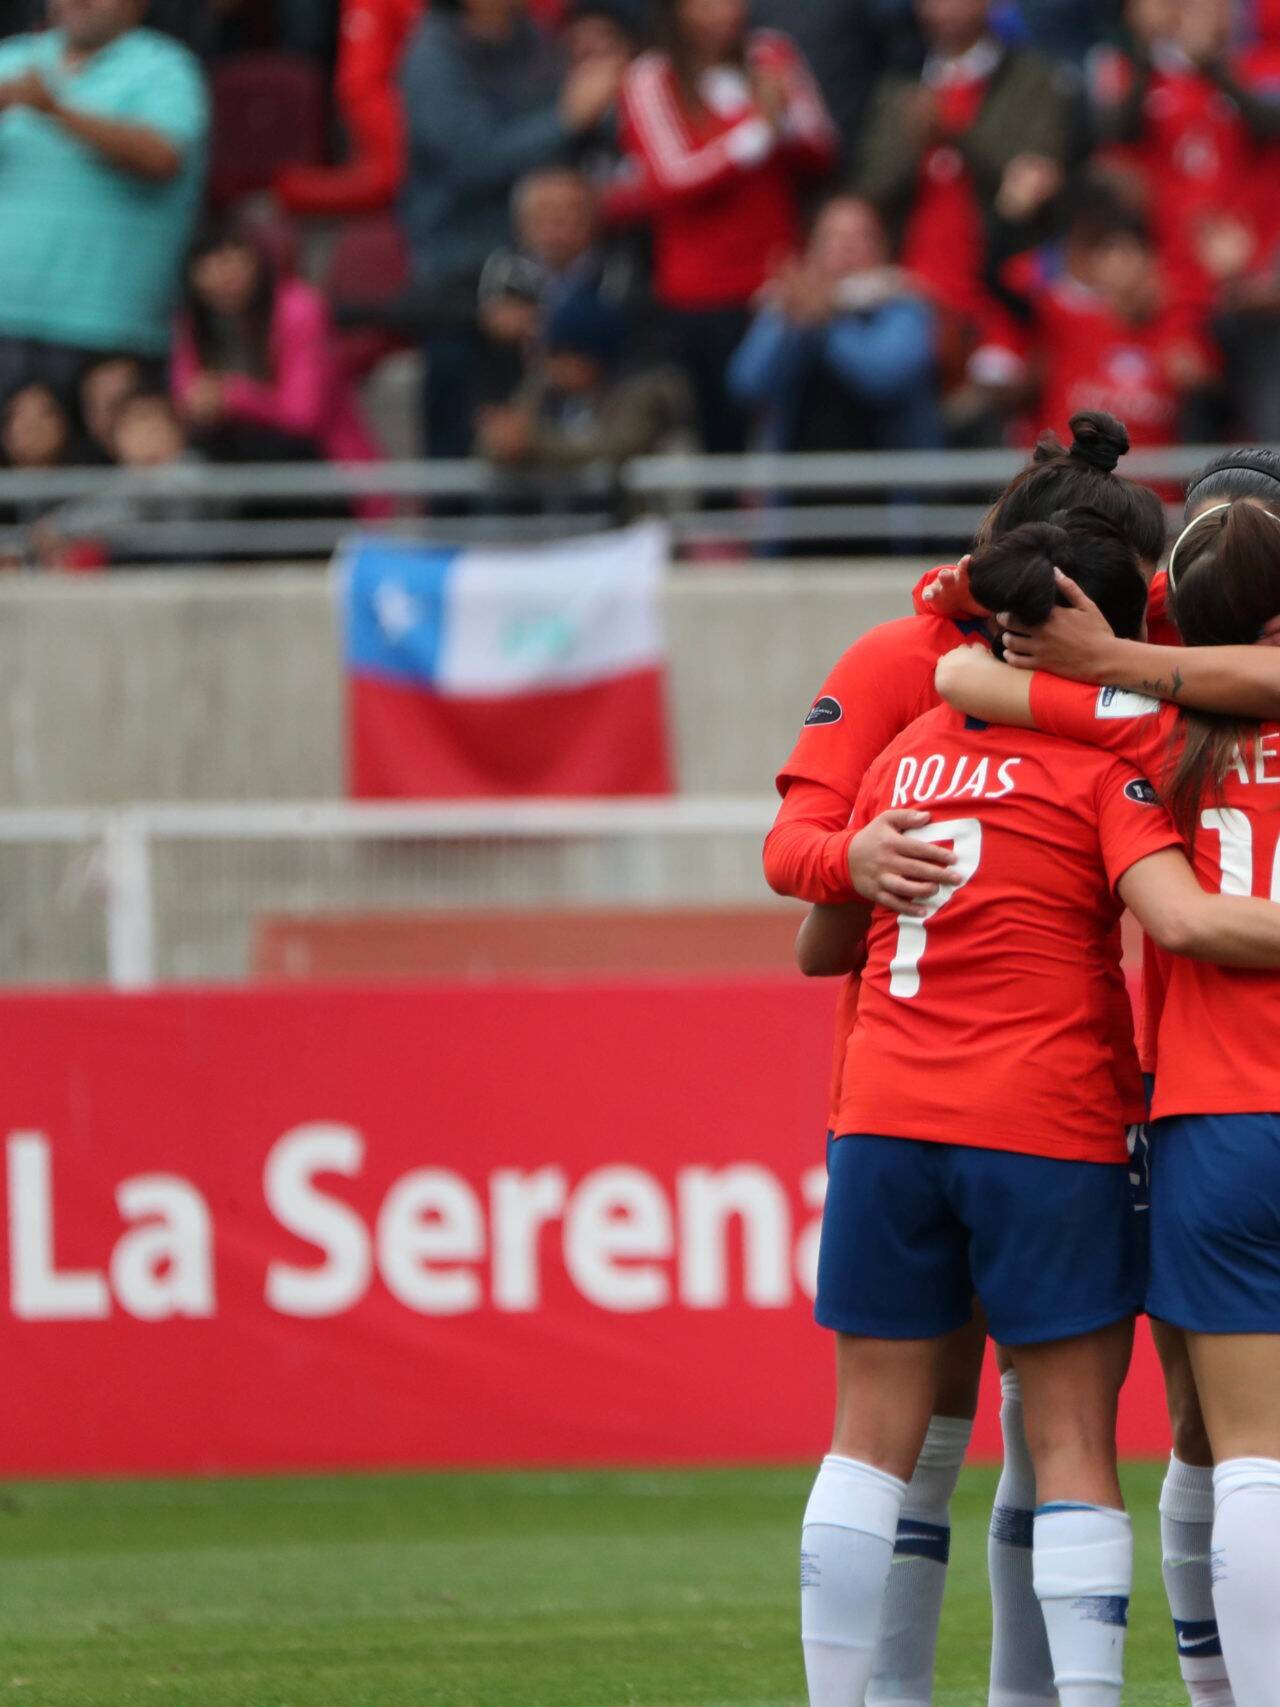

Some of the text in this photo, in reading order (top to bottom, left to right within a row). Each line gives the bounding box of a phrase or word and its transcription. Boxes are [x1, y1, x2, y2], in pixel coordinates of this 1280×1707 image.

[891, 754, 1022, 808] ROJAS
[889, 817, 983, 998] 7
[8, 1130, 216, 1322] La
